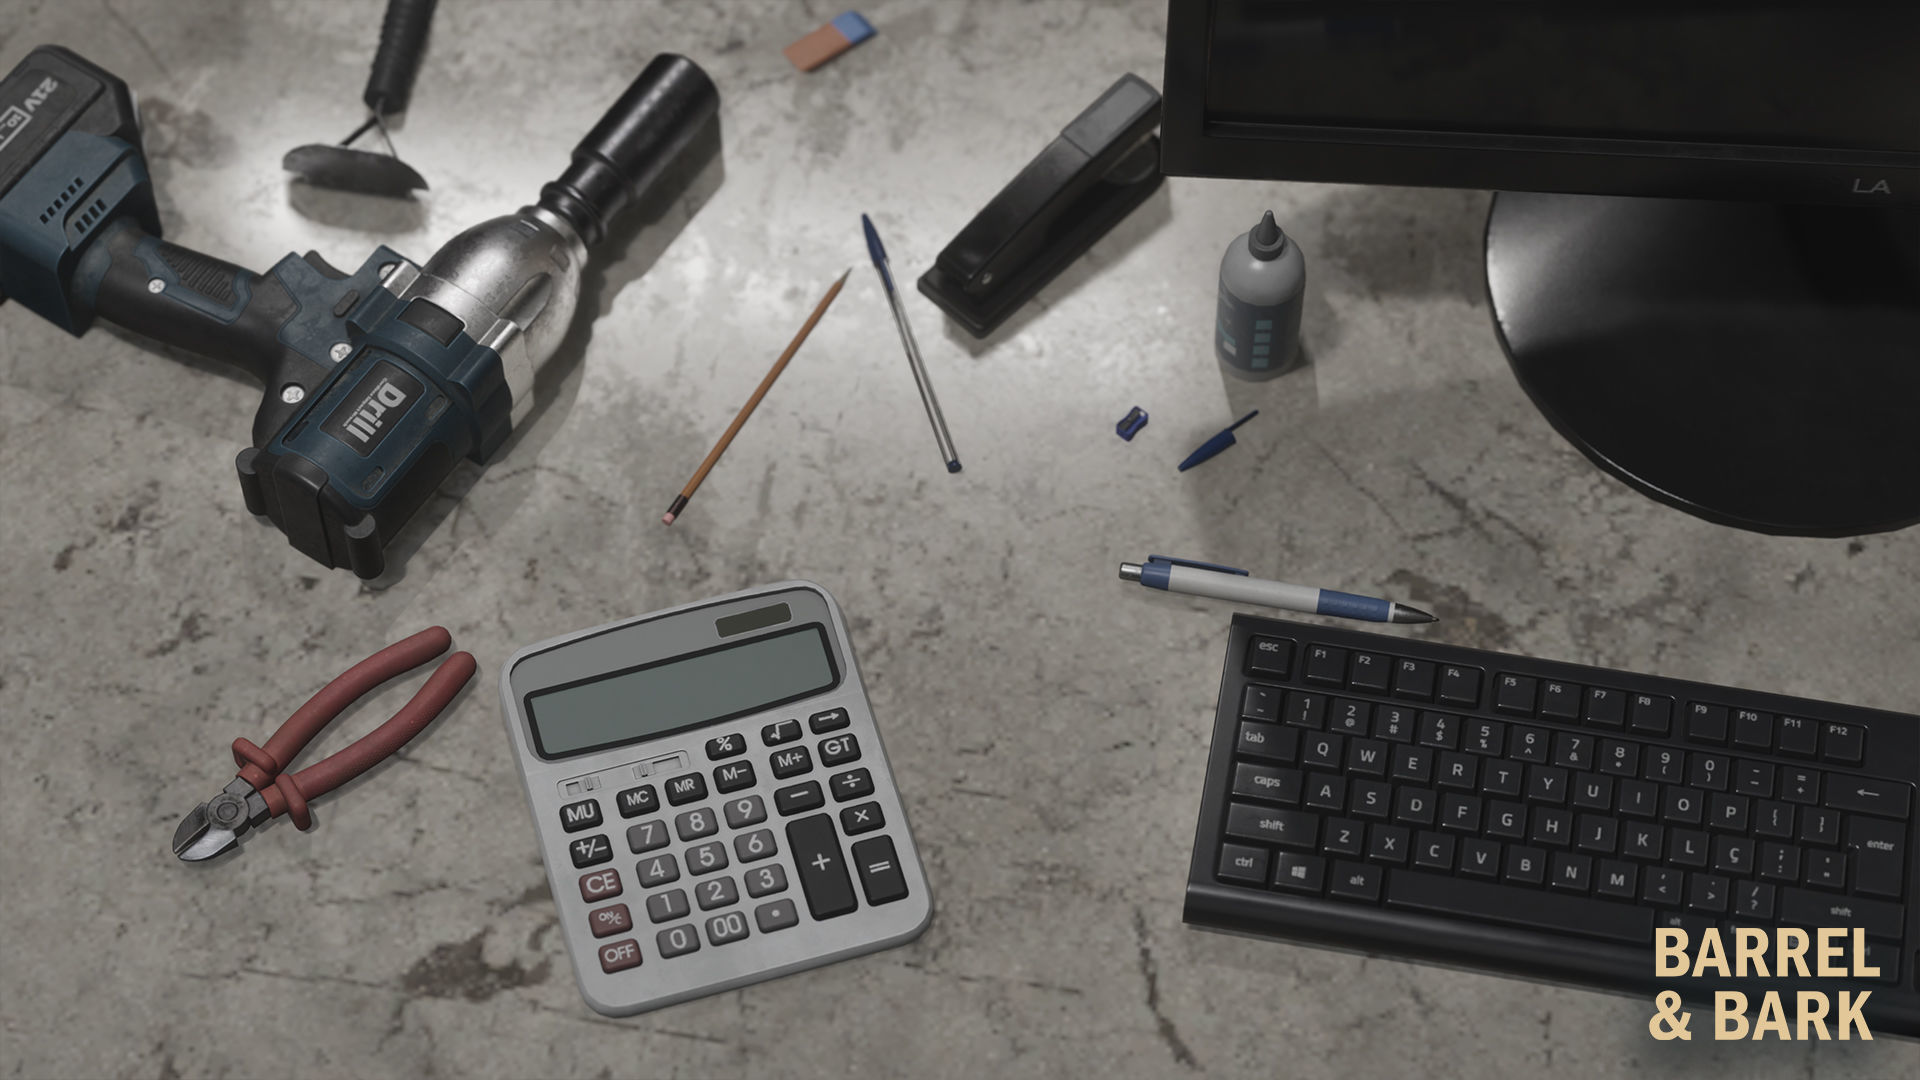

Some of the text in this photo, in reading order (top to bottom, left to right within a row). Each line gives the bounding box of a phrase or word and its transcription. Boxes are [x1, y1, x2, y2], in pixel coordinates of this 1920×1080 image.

[24, 77, 58, 113] 21V
[1853, 178, 1891, 194] LA
[345, 382, 407, 443] Drill
[1259, 642, 1278, 652] esc
[1315, 650, 1326, 658] F1
[1359, 656, 1371, 664] F2
[1403, 662, 1415, 671] F3
[1448, 669, 1459, 677] F4
[1505, 677, 1516, 686] F5
[1550, 684, 1561, 693] F6
[1595, 690, 1606, 698] F7
[1304, 699, 1310, 708] 1
[1639, 697, 1650, 705] F8
[1347, 706, 1355, 716] 2
[1696, 705, 1707, 713] F9
[1391, 712, 1399, 722] 3
[1740, 711, 1757, 721] F10
[1437, 719, 1445, 729] 4
[1784, 718, 1801, 728] F11
[1481, 726, 1489, 736] 5
[1830, 726, 1847, 735] F12
[715, 736, 732, 750] %
[1245, 731, 1264, 743] tab
[1526, 734, 1534, 744] 6
[824, 737, 849, 754] GT
[1317, 743, 1328, 756] Q
[1573, 739, 1580, 749] 7
[1361, 750, 1376, 762] W
[1615, 747, 1624, 758] 8
[1662, 753, 1670, 763] 9
[778, 753, 803, 767] M+
[1409, 757, 1418, 769] E
[1705, 760, 1714, 770] 0
[1453, 764, 1463, 776] R
[1254, 776, 1280, 788] caps
[1499, 771, 1508, 783] T
[673, 777, 695, 792] MR
[1544, 778, 1553, 789] Y
[1320, 785, 1331, 797] A
[1588, 785, 1598, 797] U
[627, 790, 648, 806] MC
[1367, 792, 1376, 804] S
[567, 802, 594, 820] MU
[738, 800, 752, 818] 9
[1411, 799, 1422, 811] D
[1678, 799, 1689, 811] O
[1458, 806, 1467, 818] F
[1726, 807, 1736, 817] P
[690, 813, 705, 831] 8
[1260, 819, 1283, 831] shift
[1502, 814, 1512, 826] G
[1547, 820, 1558, 832] H
[641, 825, 652, 844] 7
[1340, 830, 1349, 842] Z
[1595, 827, 1601, 840] J
[1638, 833, 1648, 846] K
[749, 835, 763, 853] 6
[1385, 838, 1395, 850] X
[1686, 841, 1694, 853] L
[1867, 841, 1894, 850] enter
[700, 848, 715, 866] 5
[1430, 845, 1439, 857] C
[812, 854, 830, 870] +
[1235, 857, 1253, 867] ctrl
[1477, 852, 1486, 864] V
[650, 859, 664, 877] 4
[1521, 859, 1530, 871] B
[1566, 866, 1577, 878] N
[586, 872, 616, 893] CE
[760, 869, 774, 888] 3
[1350, 876, 1364, 885] alt
[1611, 874, 1624, 886] M
[708, 882, 724, 900] 2
[661, 894, 671, 912] 1
[713, 914, 741, 937] 00
[670, 929, 686, 949] 0
[604, 943, 634, 962] OFF
